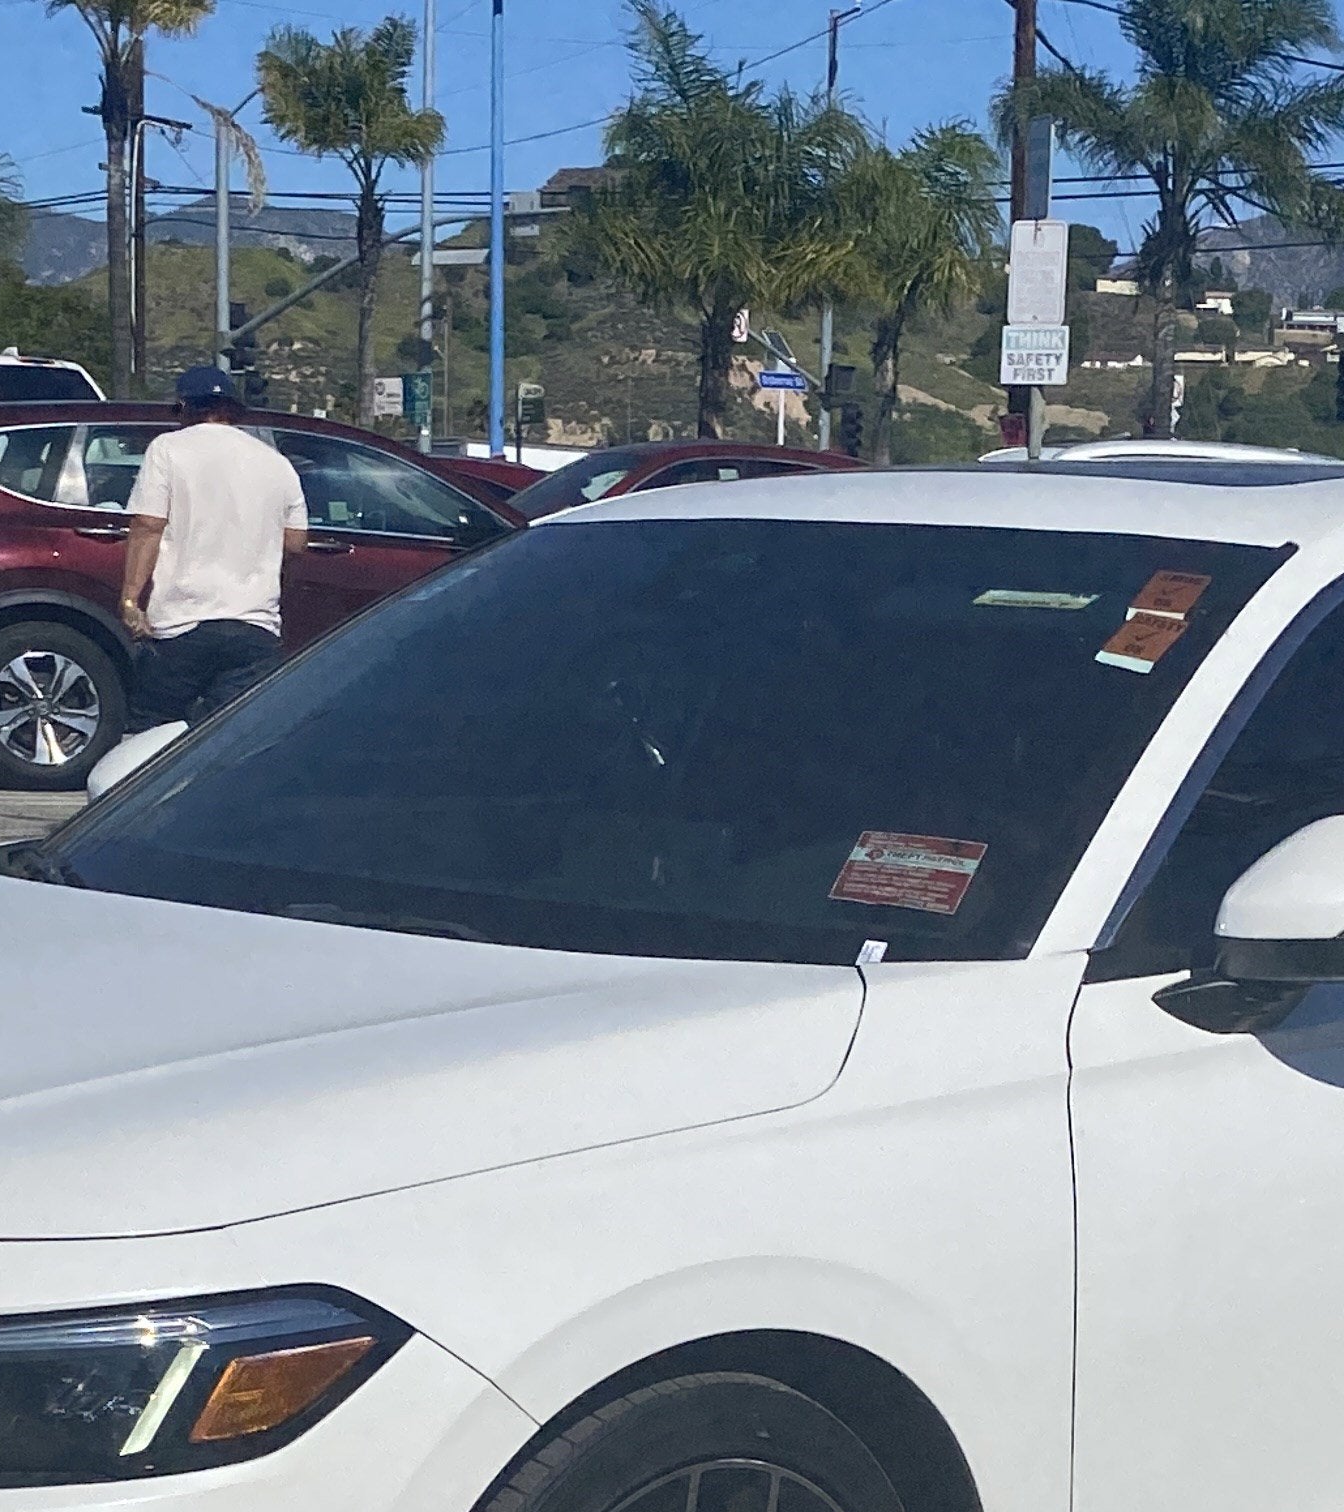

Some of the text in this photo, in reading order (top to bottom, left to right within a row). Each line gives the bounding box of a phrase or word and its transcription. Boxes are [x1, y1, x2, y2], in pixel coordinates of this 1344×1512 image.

[1007, 331, 1064, 349] THINK
[1006, 352, 1063, 366] SAFETY
[1013, 367, 1055, 381] FIRST
